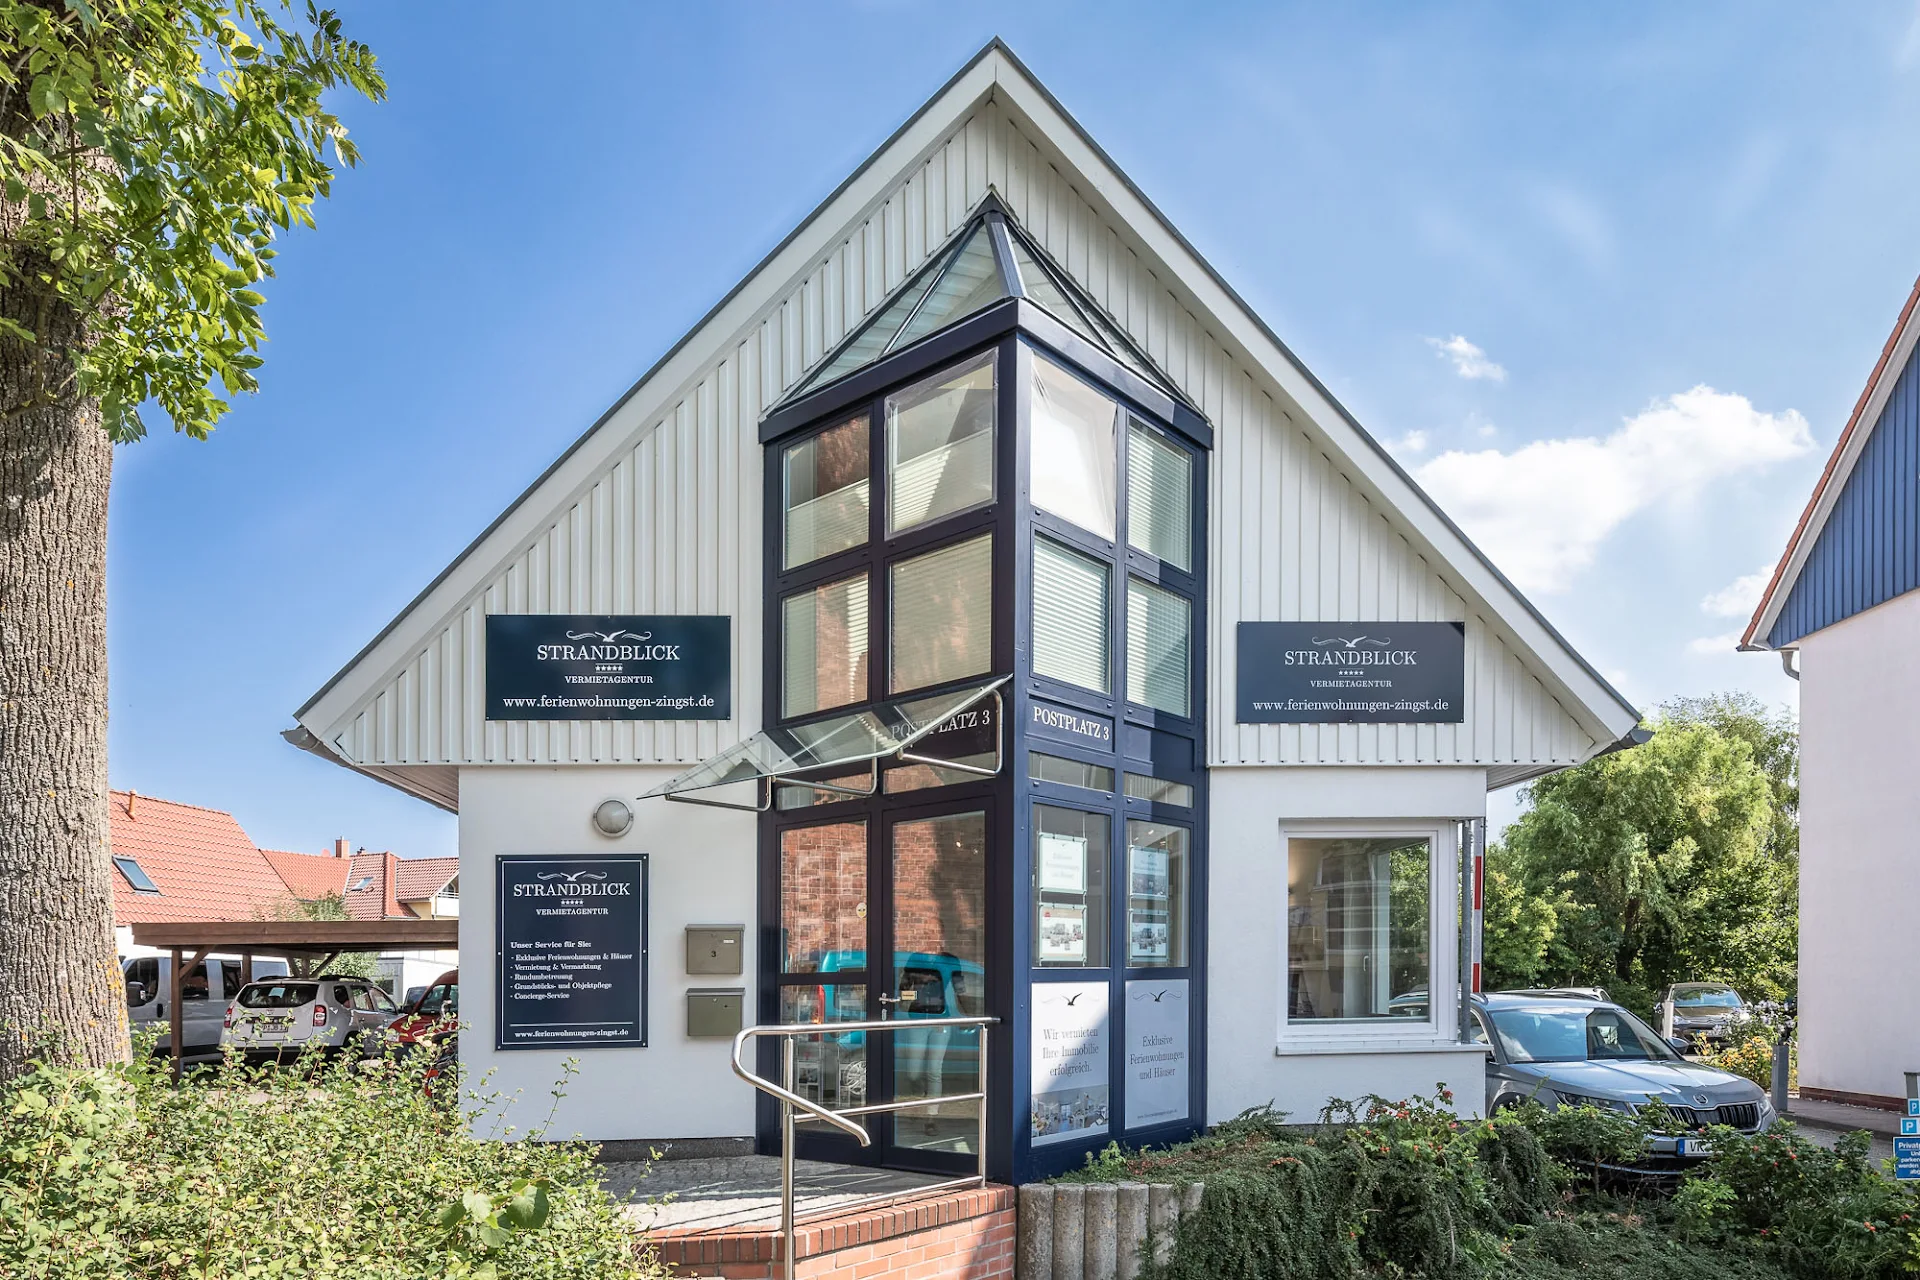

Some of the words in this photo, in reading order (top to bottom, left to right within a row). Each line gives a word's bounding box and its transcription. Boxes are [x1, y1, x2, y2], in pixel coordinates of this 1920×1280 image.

[537, 644, 680, 660] STRANDBLICK
[1284, 650, 1417, 666] STRANDBLICK
[564, 676, 654, 684] VERMIETAGENTUR
[1310, 680, 1392, 688] VERMIETAGENTUR
[502, 694, 714, 710] www.ferienwohnungen-zingst.de
[1253, 698, 1449, 713] www.ferienwohnungen-zingst.de
[982, 710, 990, 725] 3
[1032, 706, 1101, 738] POSTPLATZ
[1103, 726, 1110, 741] 3
[513, 882, 630, 896] STRANDBLICK
[536, 908, 609, 916] VERMIETAGENTUR
[548, 954, 601, 962] Ferienwohnungen
[572, 982, 612, 990] Objektpflege
[514, 1029, 629, 1038] www.ferienwohnungen-zingst.de
[1043, 1028, 1058, 1040] Wir
[1062, 1028, 1098, 1038] vermieten
[1142, 1035, 1173, 1047] Exklusive
[1042, 1047, 1058, 1059] Ihre
[1062, 1044, 1099, 1057] Immobilie
[1130, 1050, 1184, 1064] Ferienwohnungen
[1050, 1061, 1092, 1077] erfolgreich.
[1140, 1068, 1152, 1080] und
[1154, 1067, 1176, 1078] Häuser
[1911, 1102, 1917, 1112] P
[1906, 1122, 1914, 1132] P
[1898, 1142, 1920, 1150] Privat
